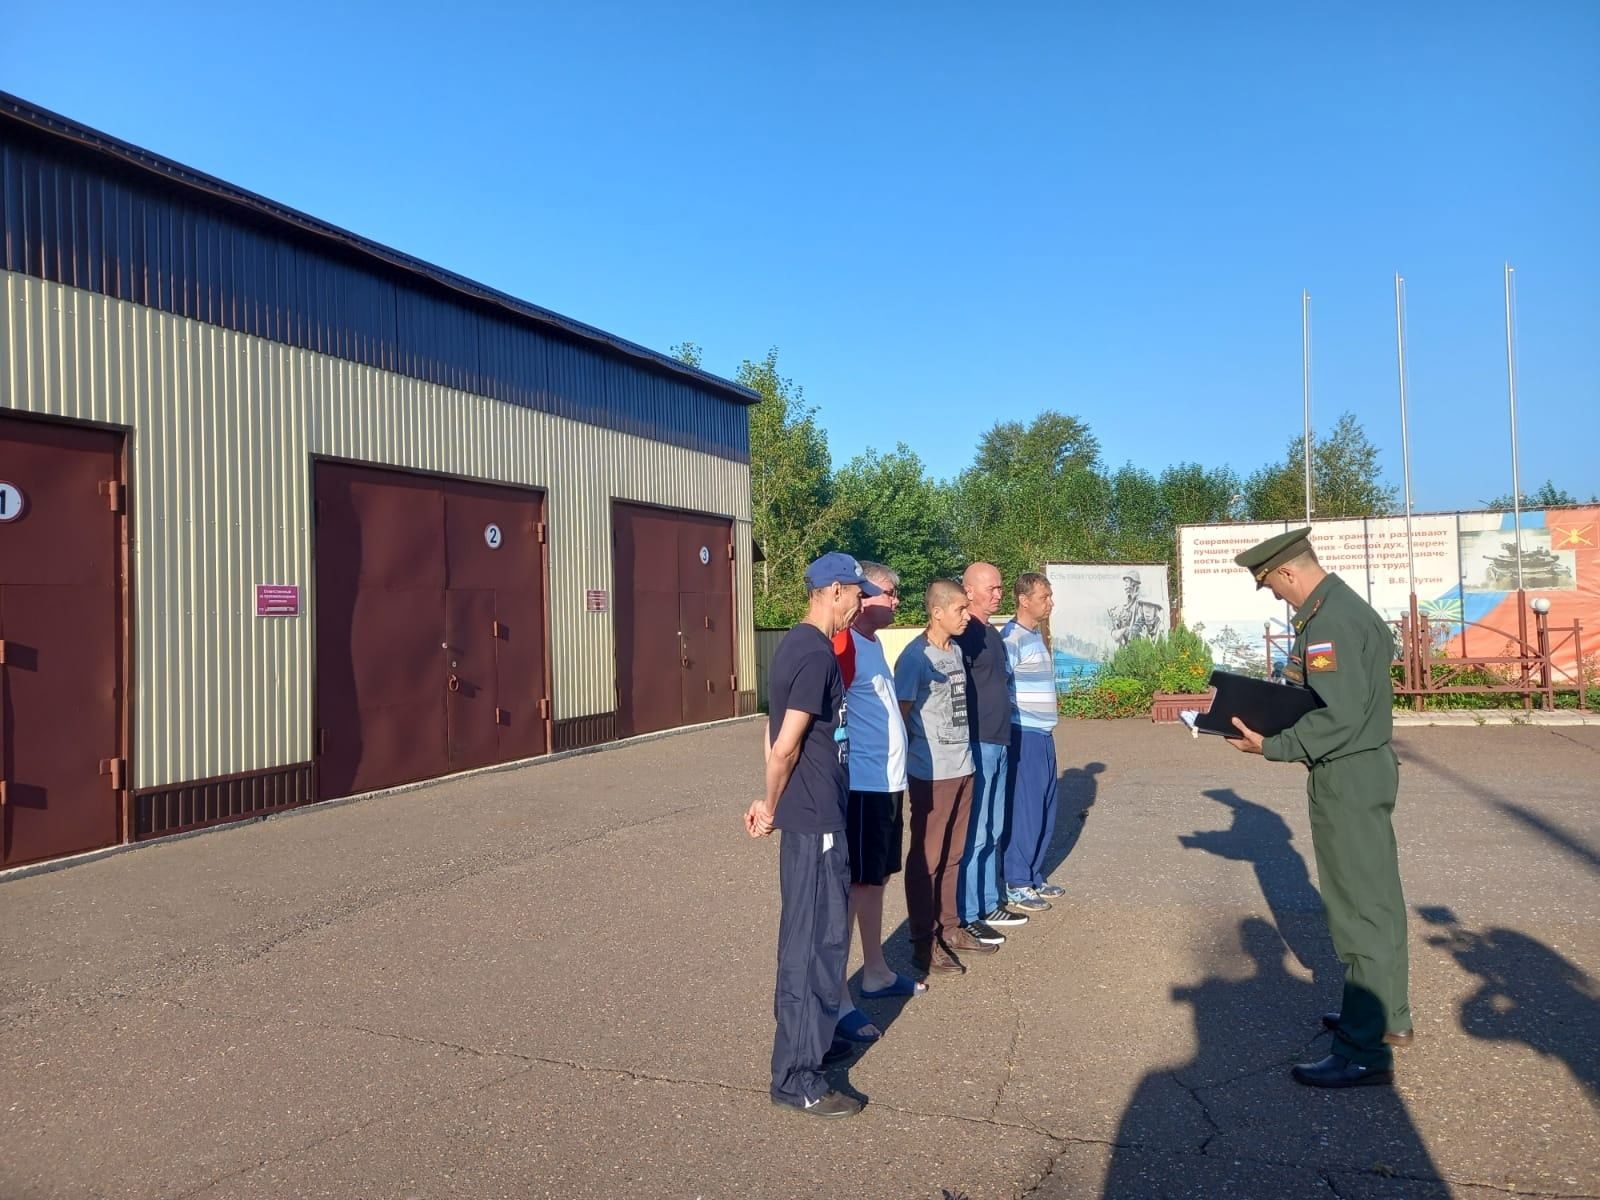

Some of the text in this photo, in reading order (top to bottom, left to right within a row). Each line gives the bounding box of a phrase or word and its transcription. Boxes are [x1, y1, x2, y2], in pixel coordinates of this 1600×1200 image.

[0, 489, 6, 515] 1
[490, 528, 496, 543] 2
[1390, 530, 1448, 539] разивают
[1376, 552, 1449, 560] преднзначе-
[954, 684, 965, 694] LINE
